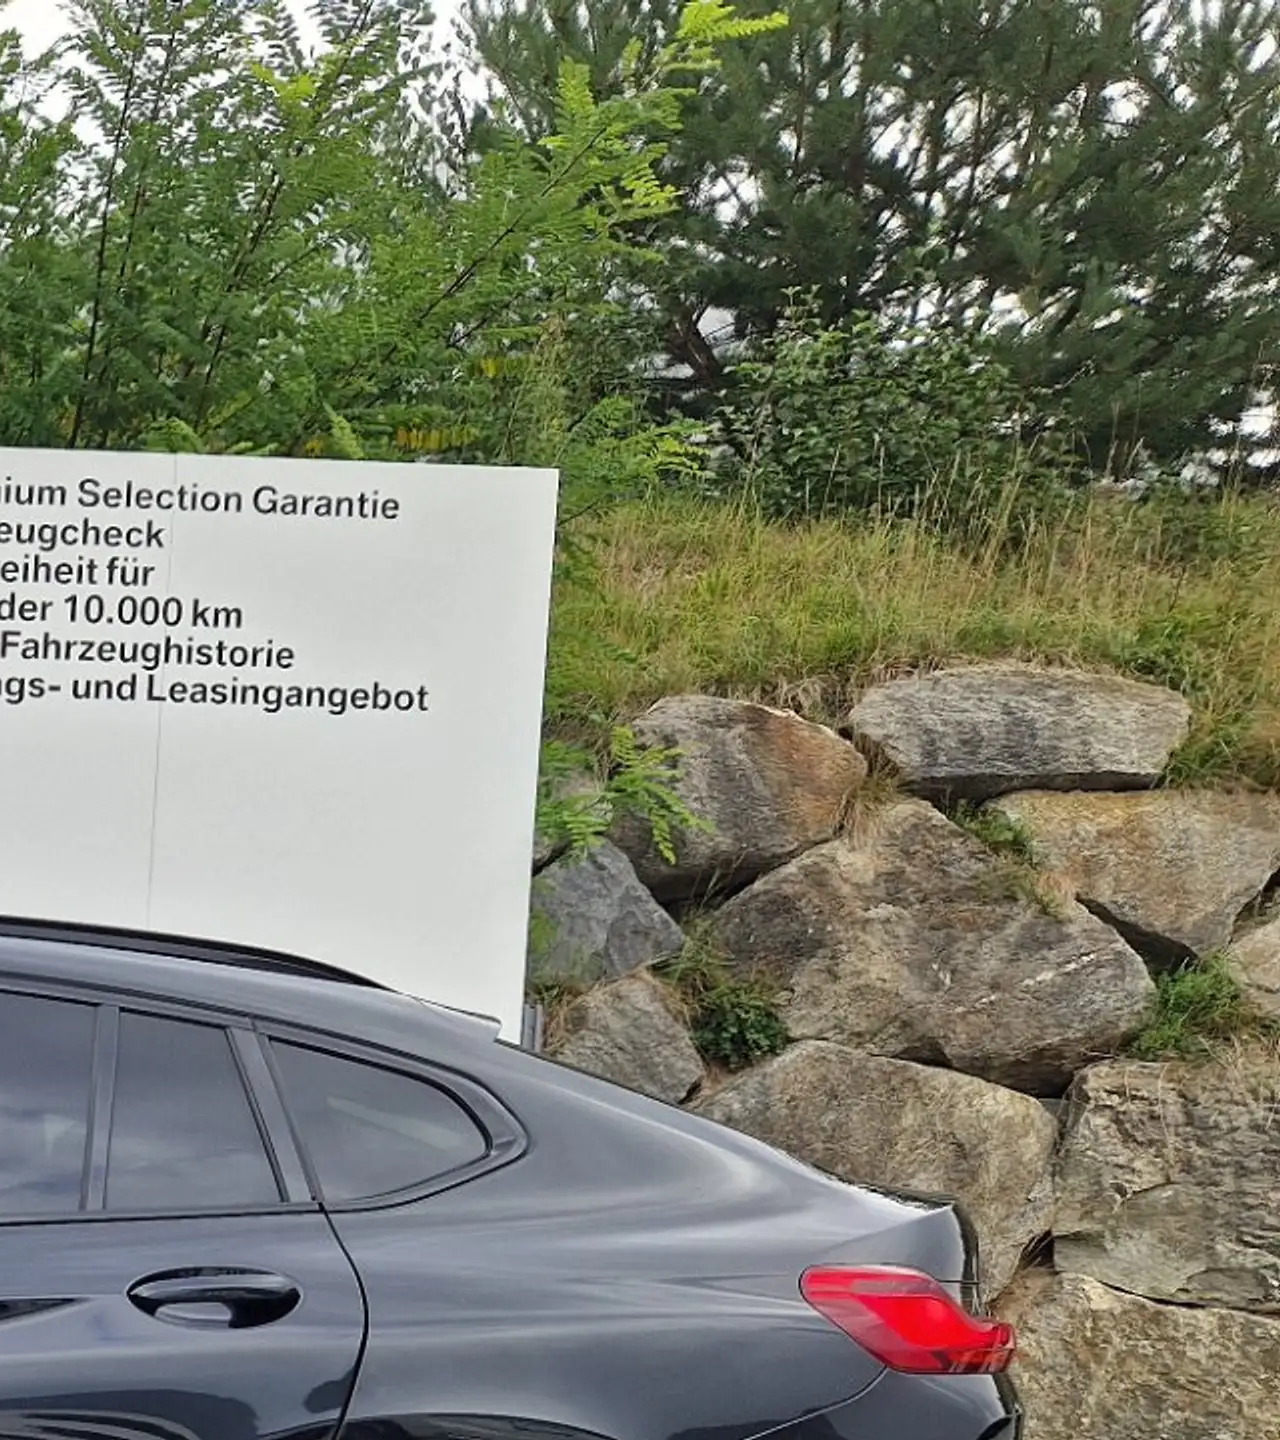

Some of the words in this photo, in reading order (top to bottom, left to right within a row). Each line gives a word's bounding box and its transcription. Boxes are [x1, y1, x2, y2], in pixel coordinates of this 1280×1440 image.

[77, 478, 242, 514] Selection
[252, 485, 400, 520] Garantie
[106, 554, 156, 587] für
[64, 594, 184, 628] 10.000
[191, 598, 243, 629] km
[0, 630, 295, 673] Fahrzeughistorie
[71, 672, 138, 704] und
[146, 673, 429, 716] Leasingangebot
